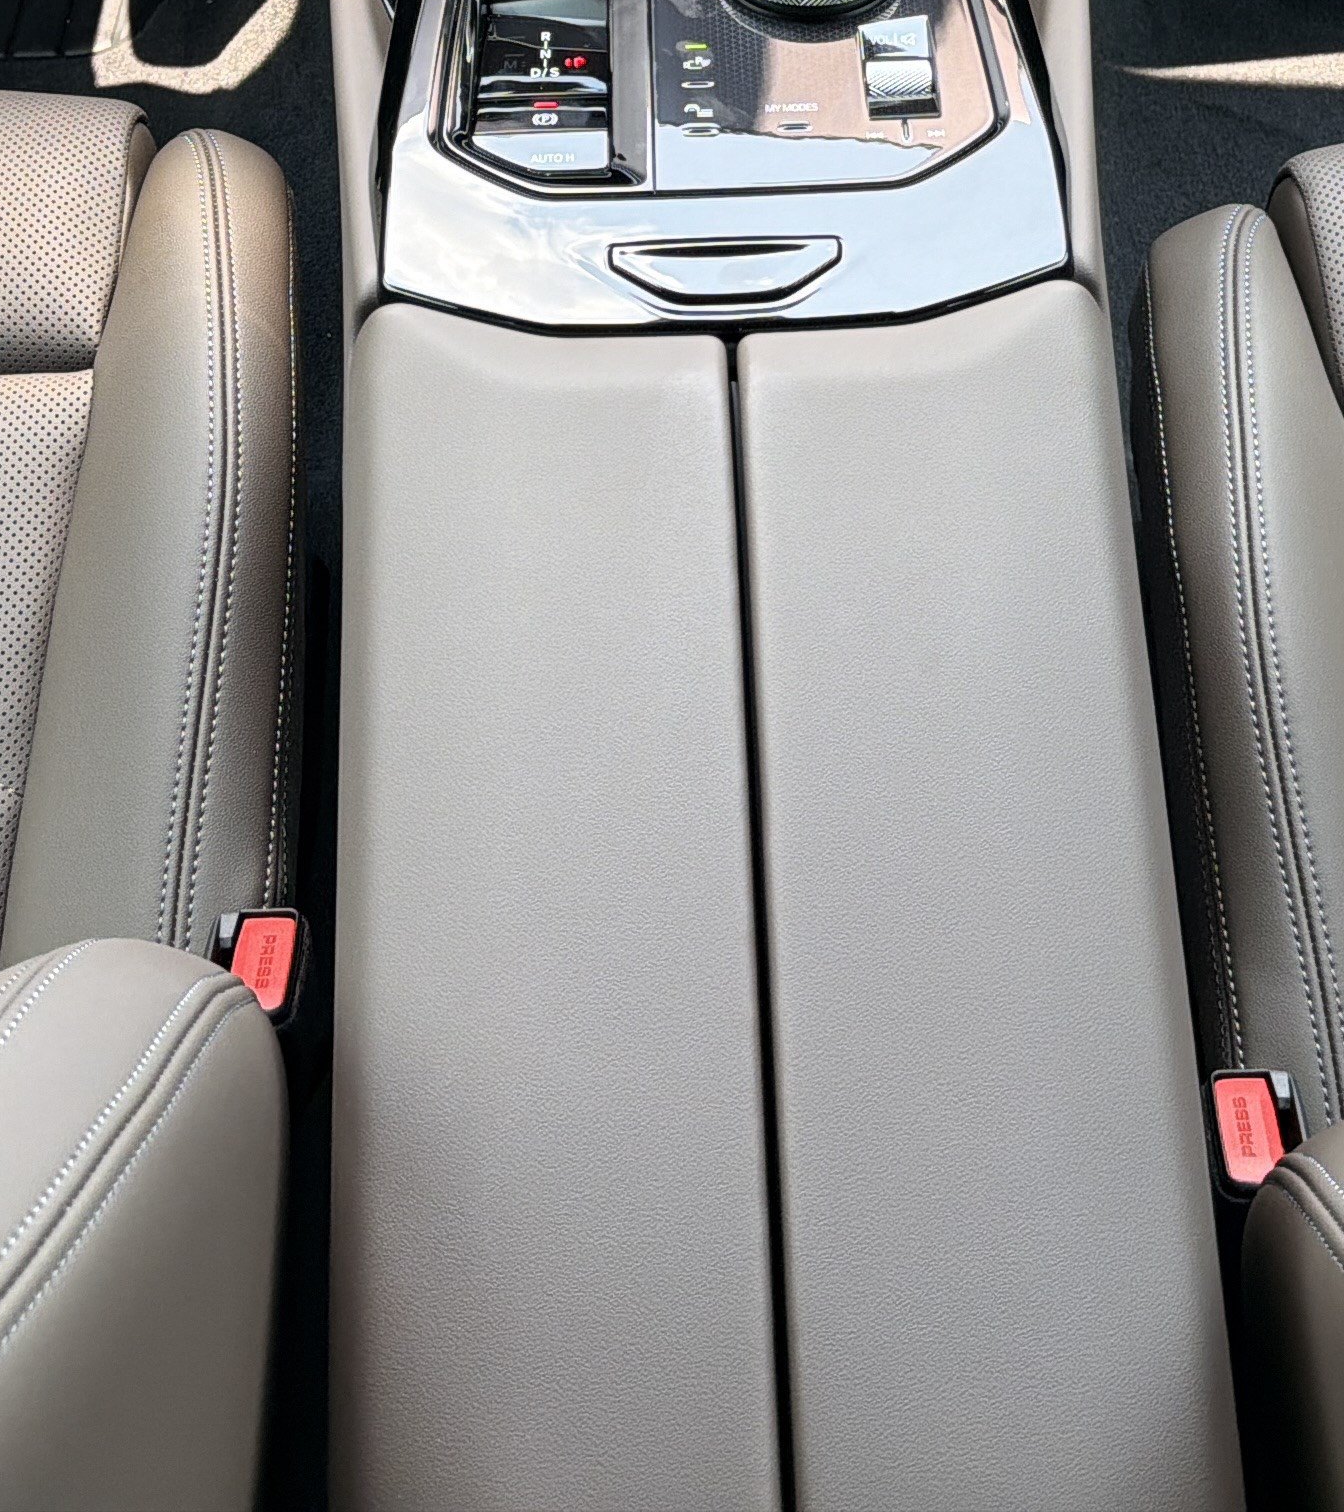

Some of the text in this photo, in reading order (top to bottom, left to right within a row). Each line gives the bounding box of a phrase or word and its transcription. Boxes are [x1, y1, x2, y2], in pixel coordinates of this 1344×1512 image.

[540, 31, 552, 42] R
[869, 34, 892, 45] VOL
[539, 48, 552, 60] N
[530, 66, 561, 79] D/S
[764, 102, 819, 114] MY MODES
[530, 152, 575, 163] AUTO H
[254, 934, 278, 990] PRESS
[1232, 1095, 1257, 1158] PRESS
